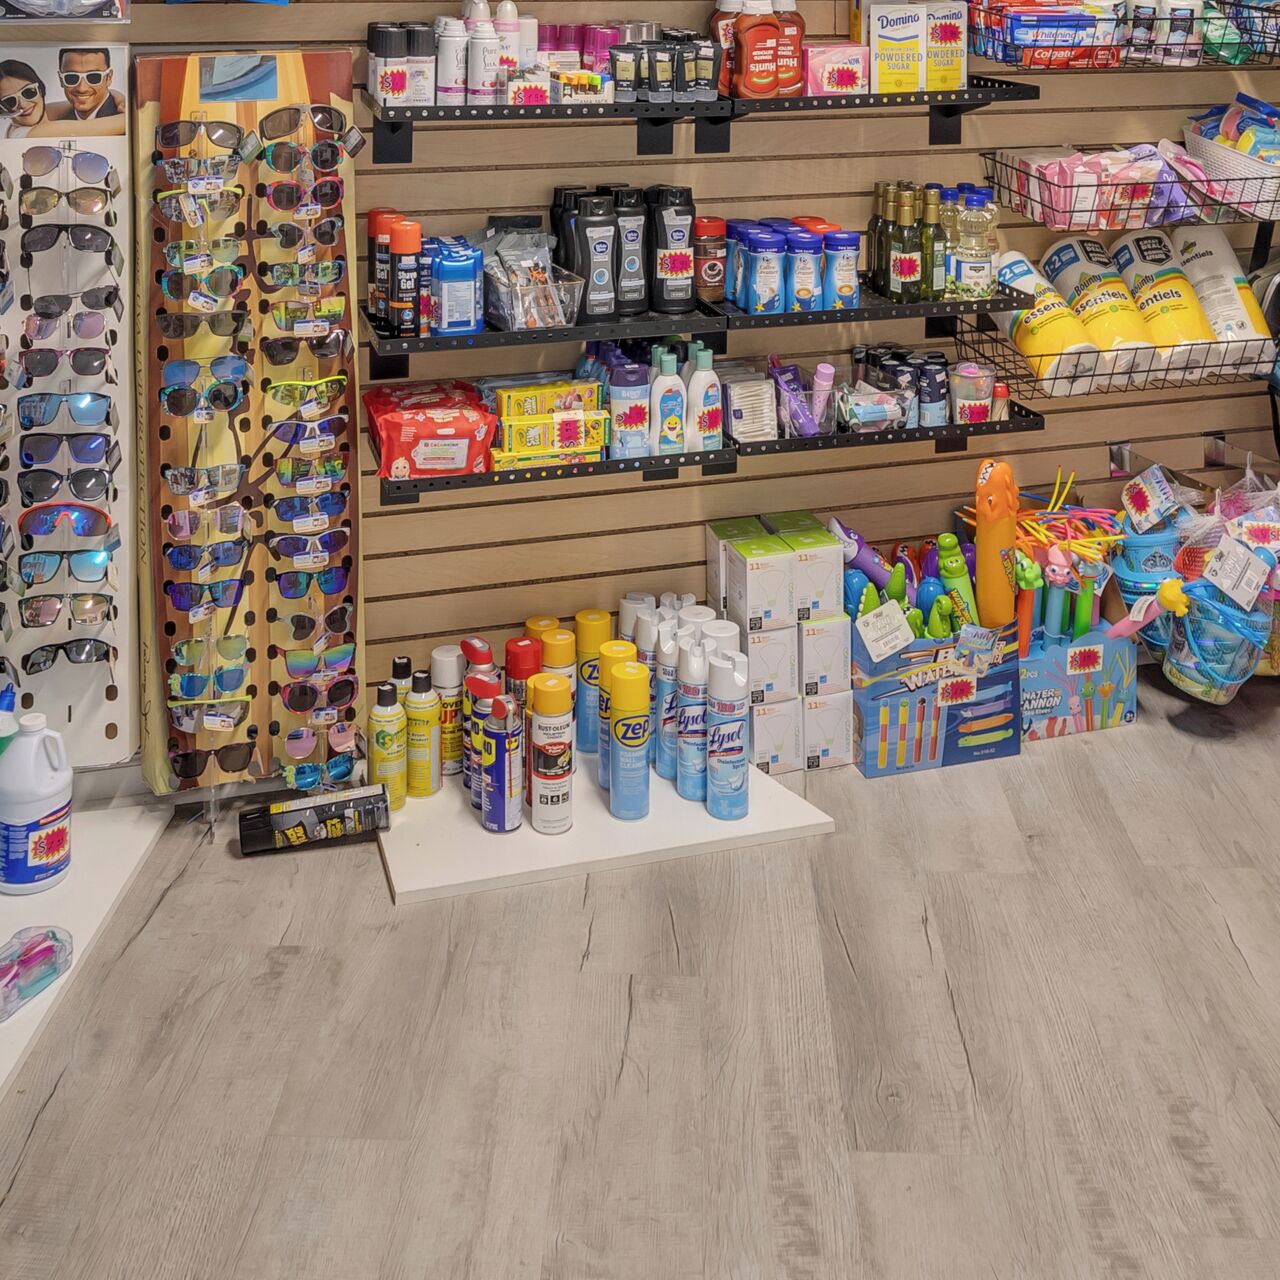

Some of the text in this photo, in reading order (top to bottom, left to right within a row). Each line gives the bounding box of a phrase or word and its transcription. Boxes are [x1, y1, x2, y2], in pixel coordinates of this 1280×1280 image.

[877, 12, 920, 30] Domino
[1032, 30, 1077, 40] Whitening
[874, 52, 923, 62] POWDERED
[927, 48, 965, 59] OWDERED
[1034, 49, 1075, 59] Colgate
[777, 58, 798, 67] Hun
[887, 62, 911, 70] SUGAR
[933, 59, 954, 67] SUGAR
[398, 271, 417, 280] Shave
[400, 279, 415, 289] Gel
[1073, 273, 1103, 297] Bounty
[1074, 290, 1128, 316] ssentiels
[1139, 289, 1182, 311] entiels
[1023, 688, 1055, 698] WATER
[1022, 696, 1061, 710] ANNON
[709, 722, 744, 750] Lysol
